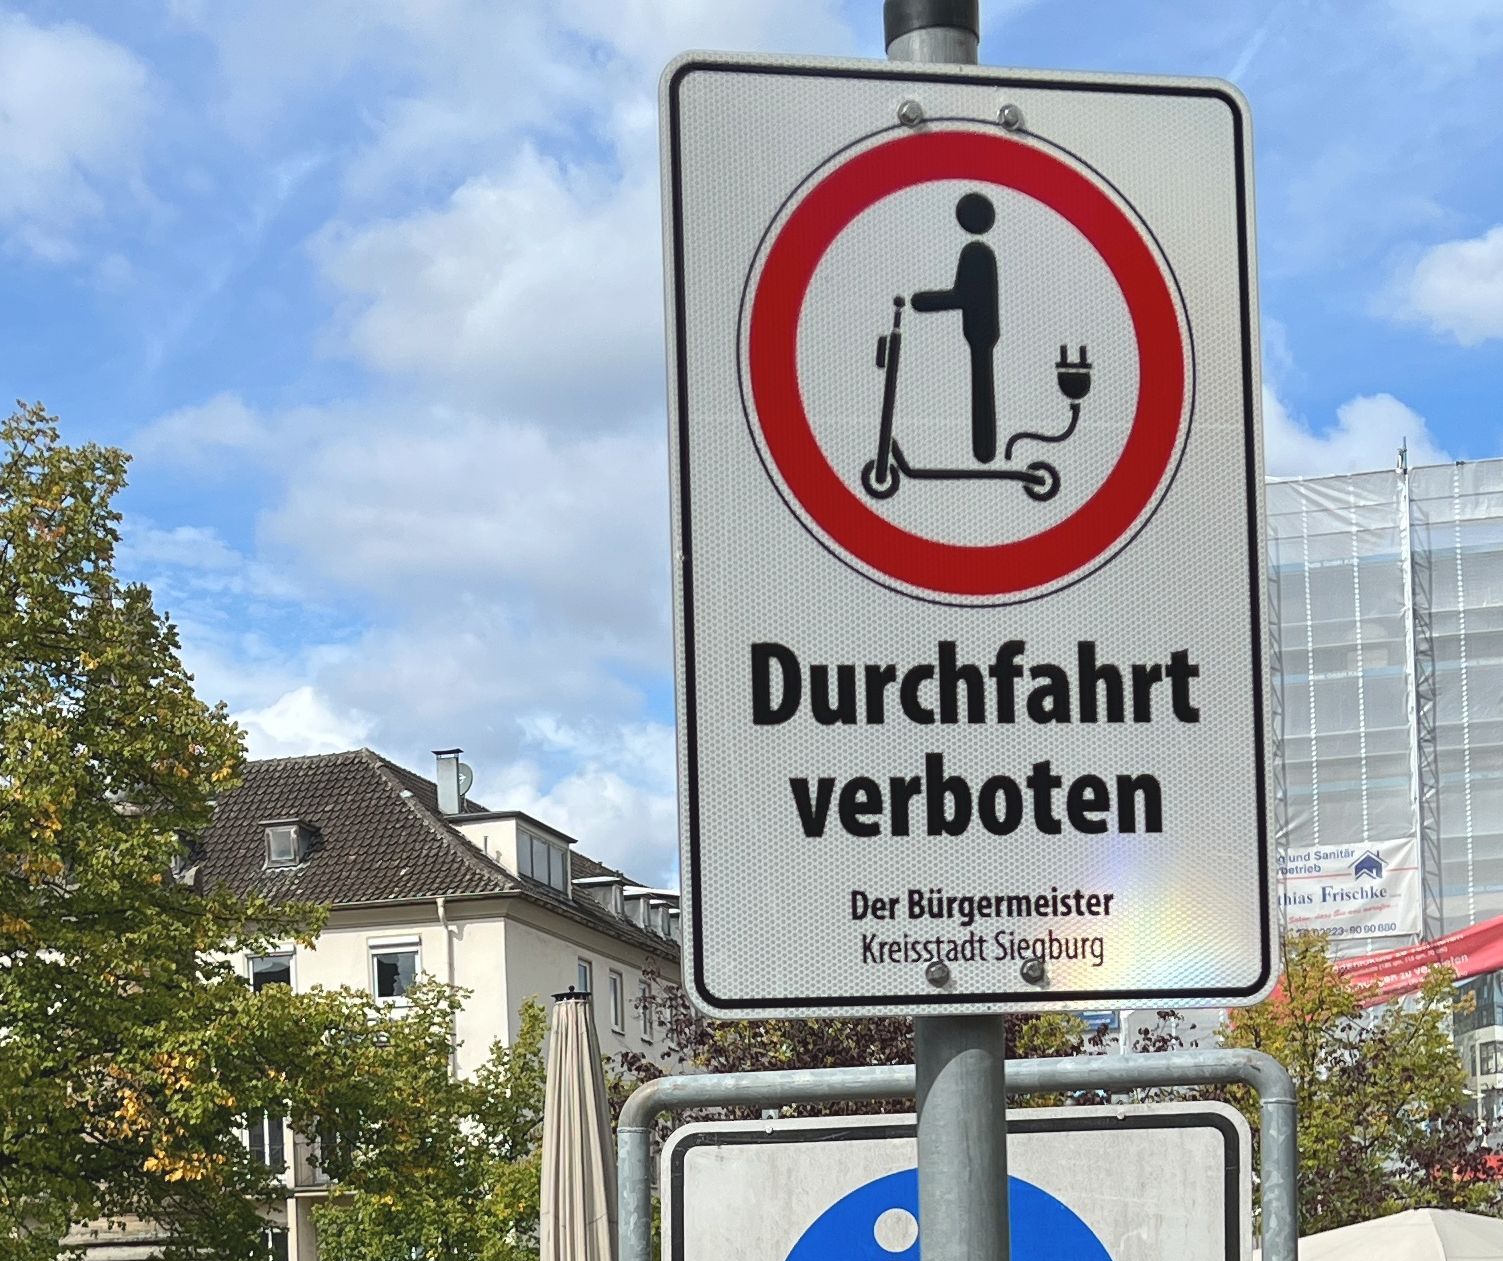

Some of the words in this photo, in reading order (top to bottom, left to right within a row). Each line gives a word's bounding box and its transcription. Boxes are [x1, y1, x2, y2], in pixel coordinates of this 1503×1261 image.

[750, 640, 1201, 726] Durchfahrt
[789, 752, 1164, 838] verboten
[1280, 864, 1322, 875] betrieb
[1288, 852, 1311, 863] und
[1314, 848, 1356, 861] Sanitär
[850, 890, 899, 920] Der
[906, 887, 1114, 926] Bürgermeister
[1278, 892, 1314, 906] thias
[1321, 885, 1388, 903] Frischke
[862, 932, 986, 964] Kreisstadt
[994, 929, 1105, 967] Siegburg
